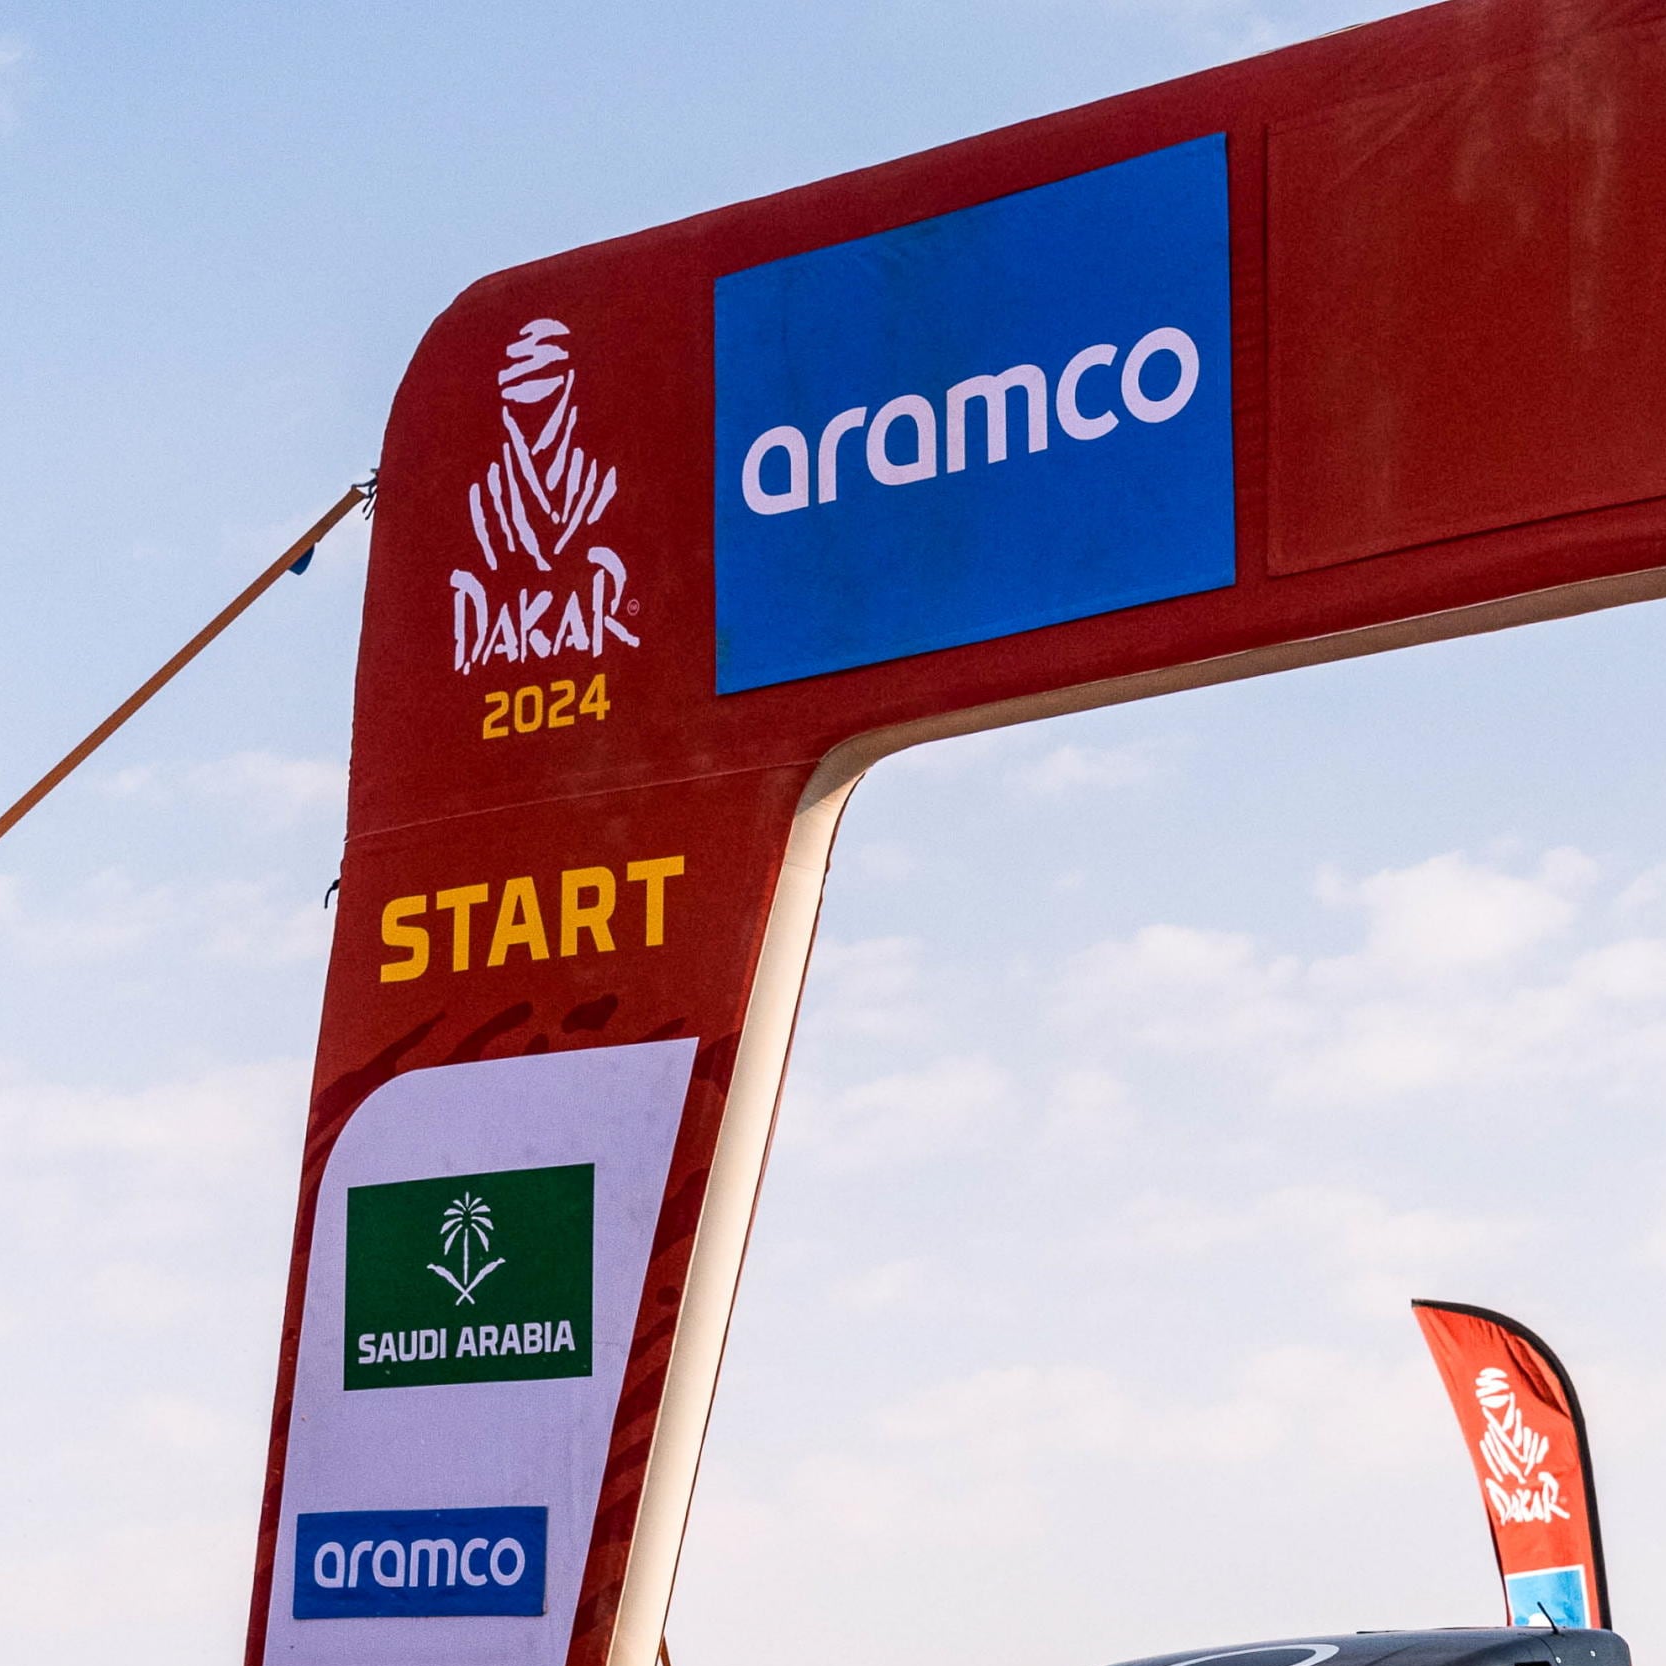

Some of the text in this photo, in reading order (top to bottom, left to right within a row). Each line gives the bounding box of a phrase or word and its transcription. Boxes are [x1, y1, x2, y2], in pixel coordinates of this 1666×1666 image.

[741, 326, 1200, 516] aramco
[450, 546, 640, 676] DAKAR
[483, 673, 611, 740] 2024
[380, 855, 685, 984] START
[358, 1320, 575, 1365] SAUDI ARABIA
[1485, 1471, 1571, 1525] DAKAR
[314, 1537, 526, 1588] aramco
